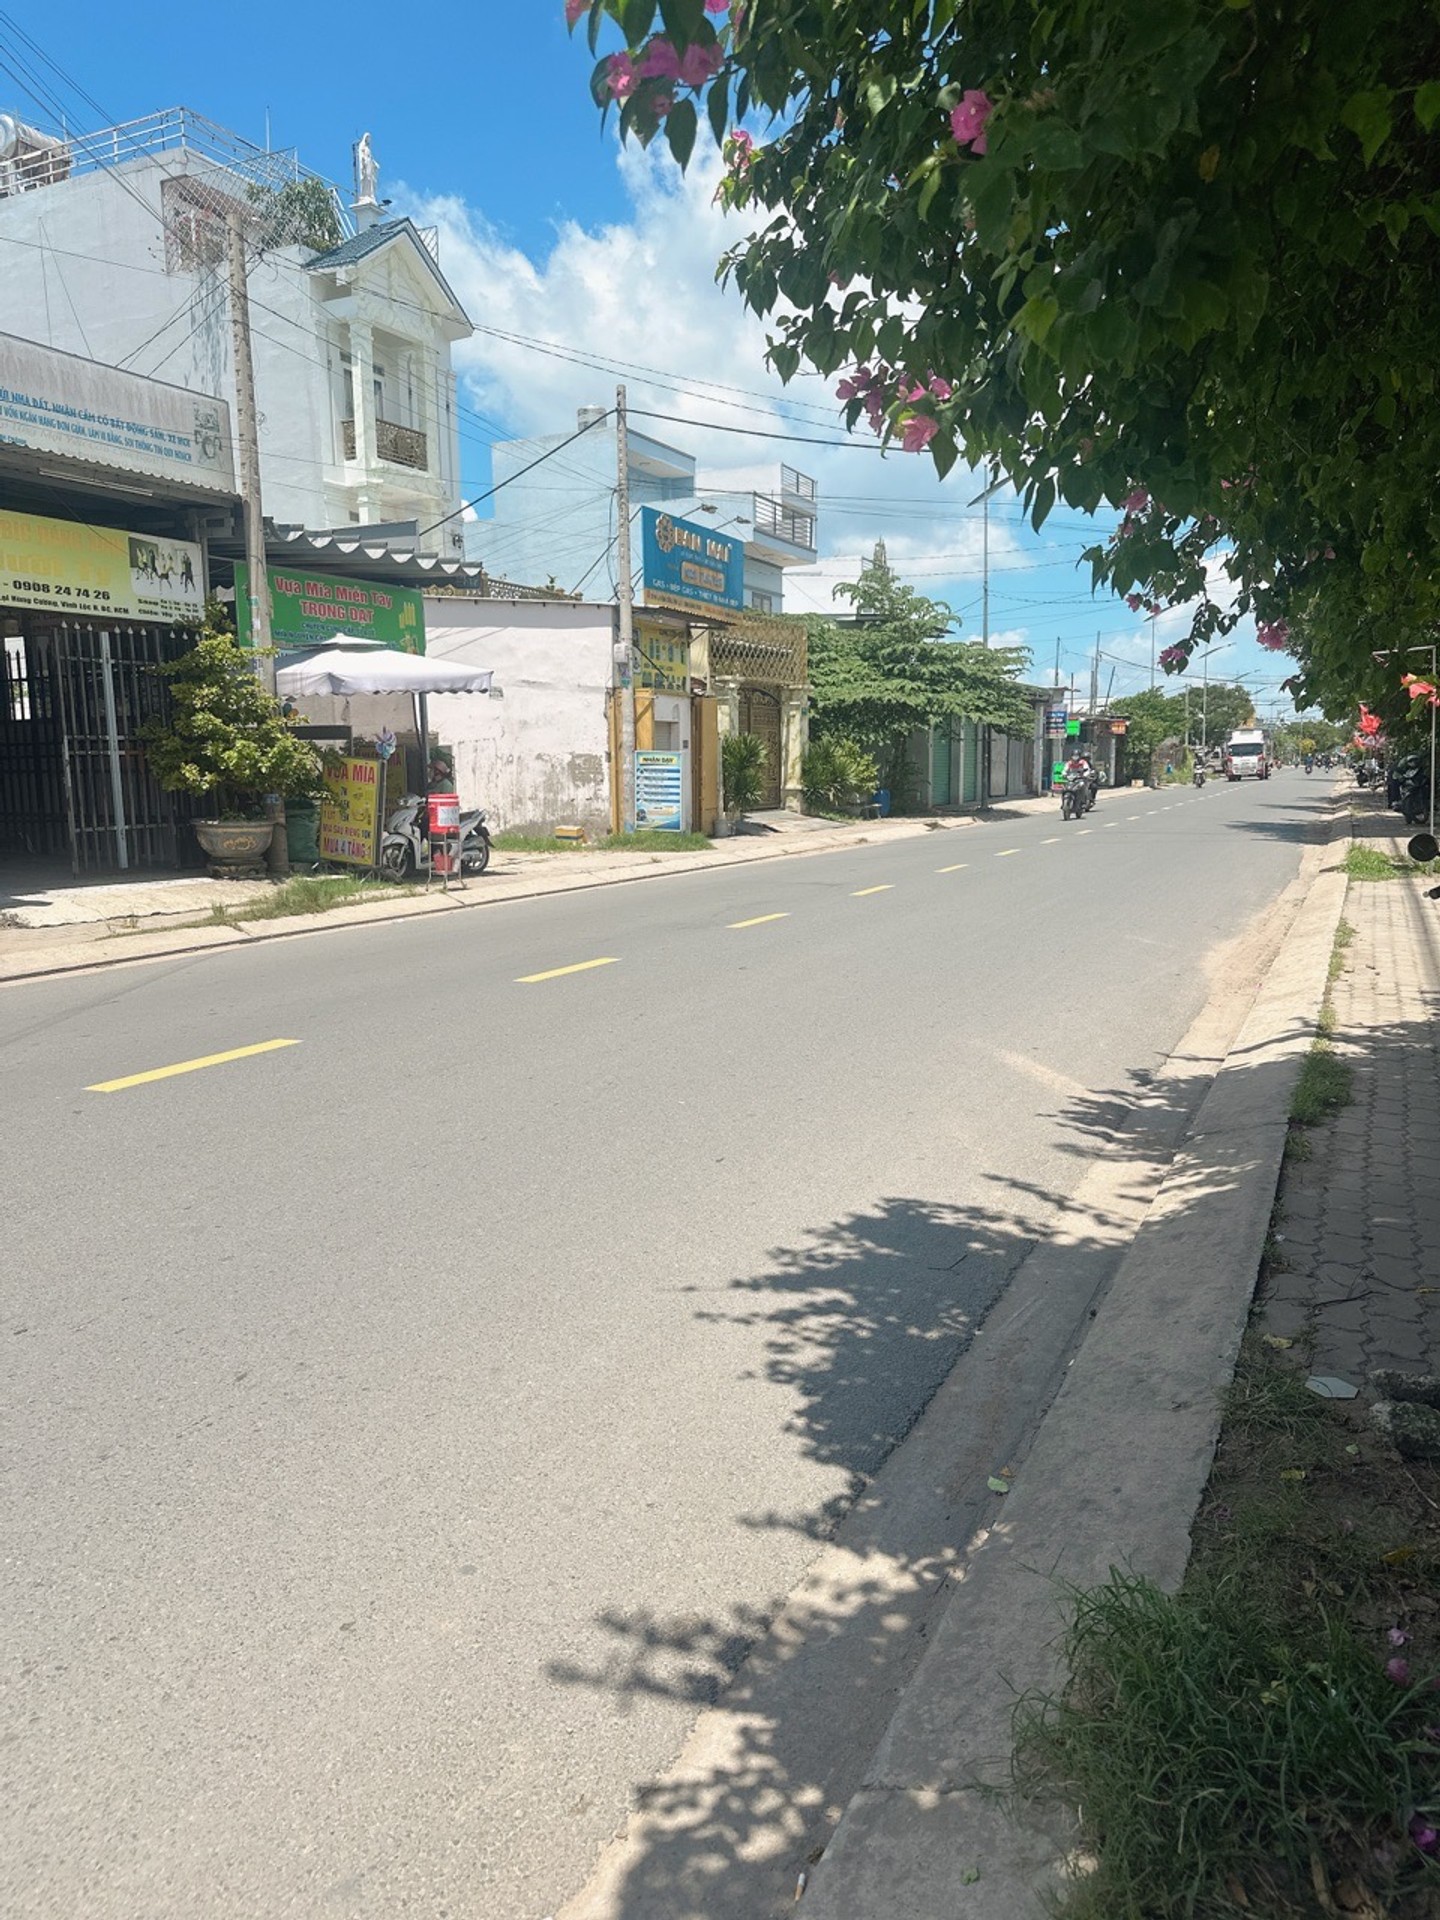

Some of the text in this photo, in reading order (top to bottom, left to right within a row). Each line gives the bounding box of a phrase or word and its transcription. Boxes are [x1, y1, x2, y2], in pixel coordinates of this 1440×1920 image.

[12, 579, 51, 595] 0908
[54, 585, 72, 597] 24
[75, 587, 91, 599] 74
[274, 577, 392, 609] Vựa Mía Miền Tây
[300, 601, 375, 625] TRỌNG ĐẠT
[352, 761, 376, 785] MÍA
